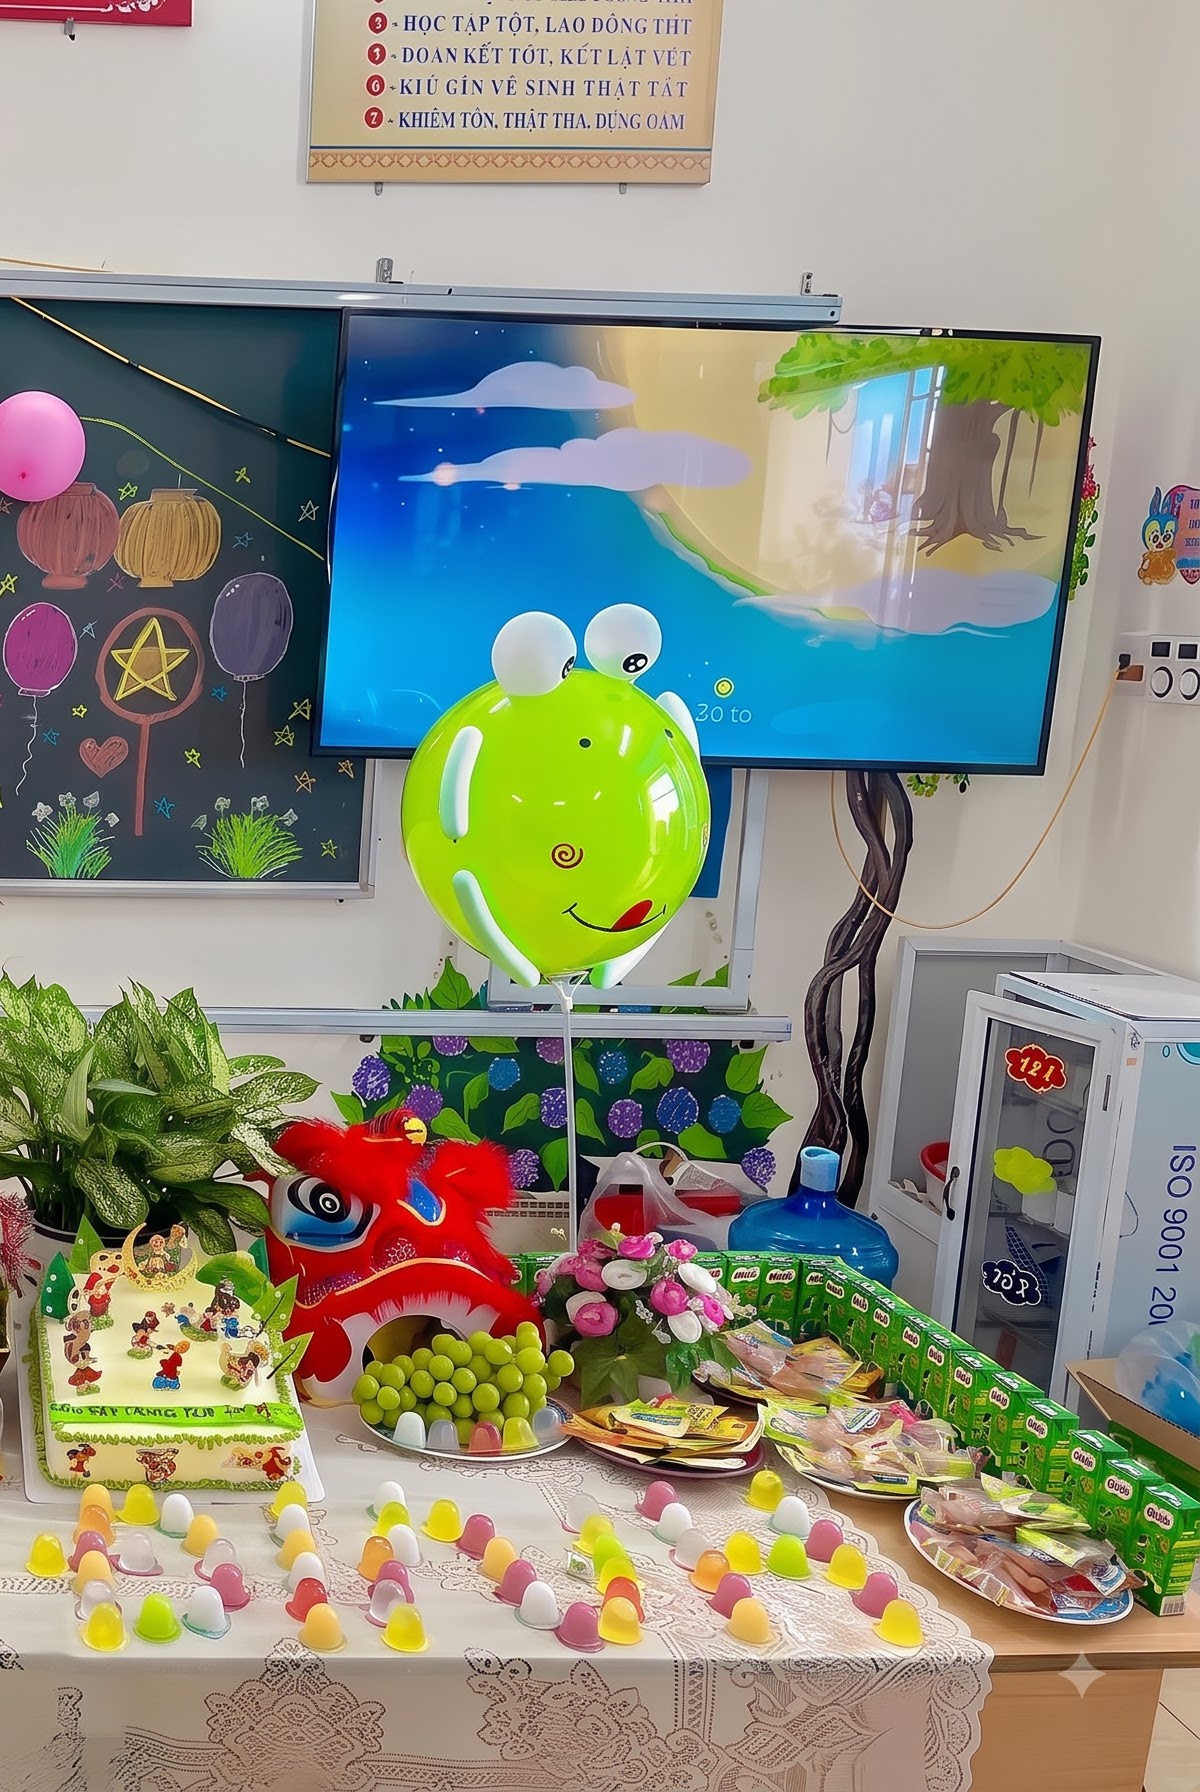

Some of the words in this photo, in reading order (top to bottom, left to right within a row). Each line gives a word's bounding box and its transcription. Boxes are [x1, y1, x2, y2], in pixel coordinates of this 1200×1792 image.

[403, 15, 447, 36] HỌC
[546, 16, 586, 33] LAO
[525, 79, 575, 97] SINH
[1166, 1145, 1197, 1198] ISO
[1155, 1208, 1188, 1273] 9001
